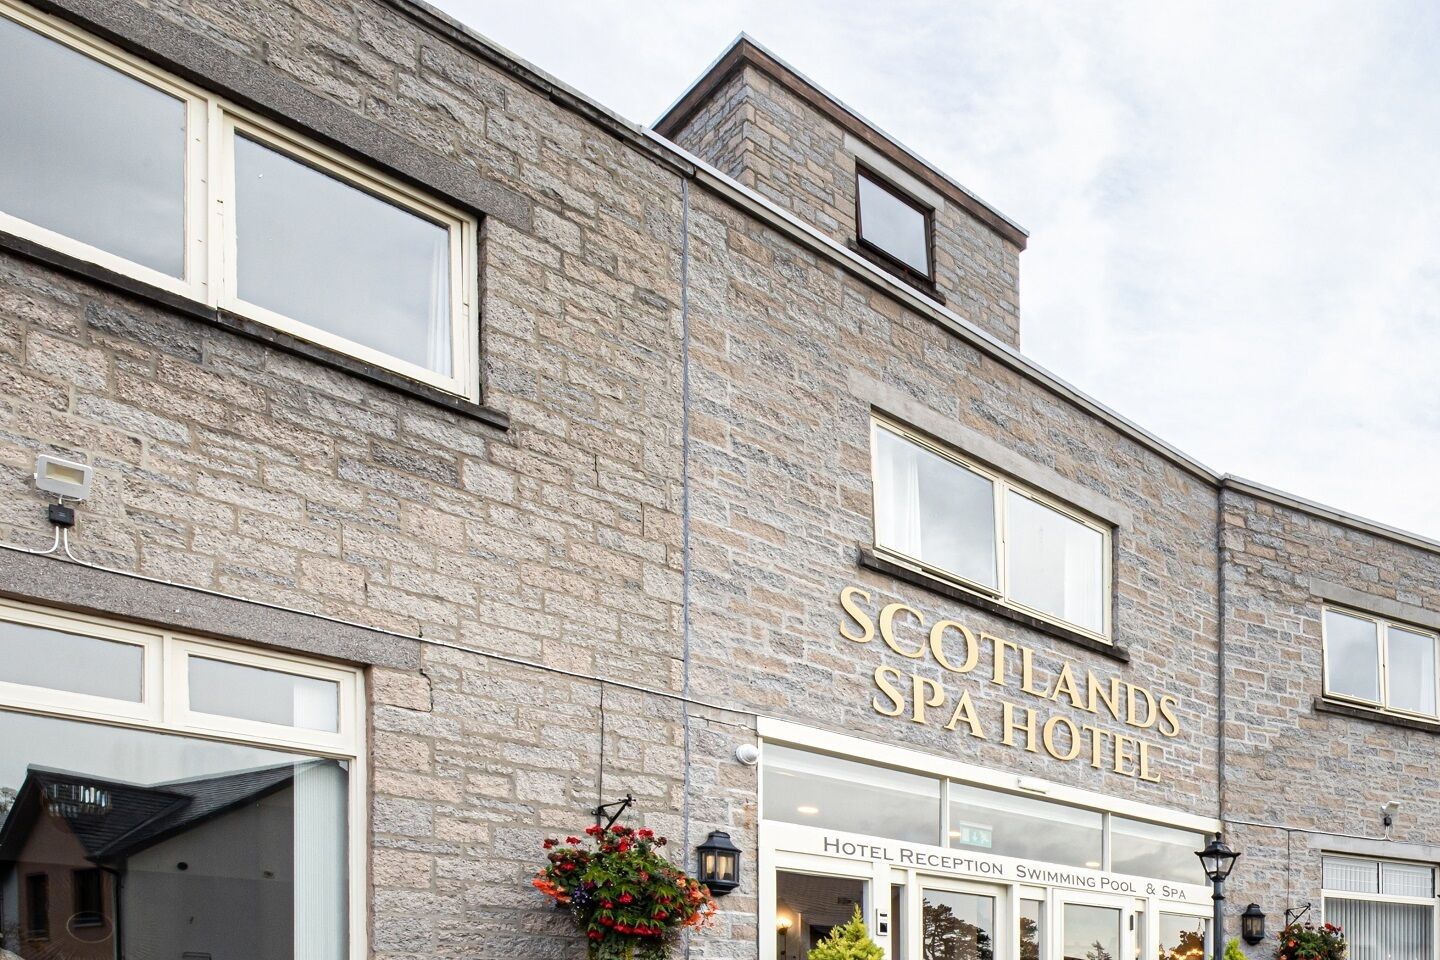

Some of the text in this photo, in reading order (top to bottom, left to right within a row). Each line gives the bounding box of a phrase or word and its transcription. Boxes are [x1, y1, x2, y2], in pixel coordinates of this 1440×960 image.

[839, 586, 1181, 738] SCOTLANDS
[872, 665, 1161, 783] SPA HOTEL
[823, 836, 1187, 900] HOTEL RECEPTION SWIMMING POOL & SPA
